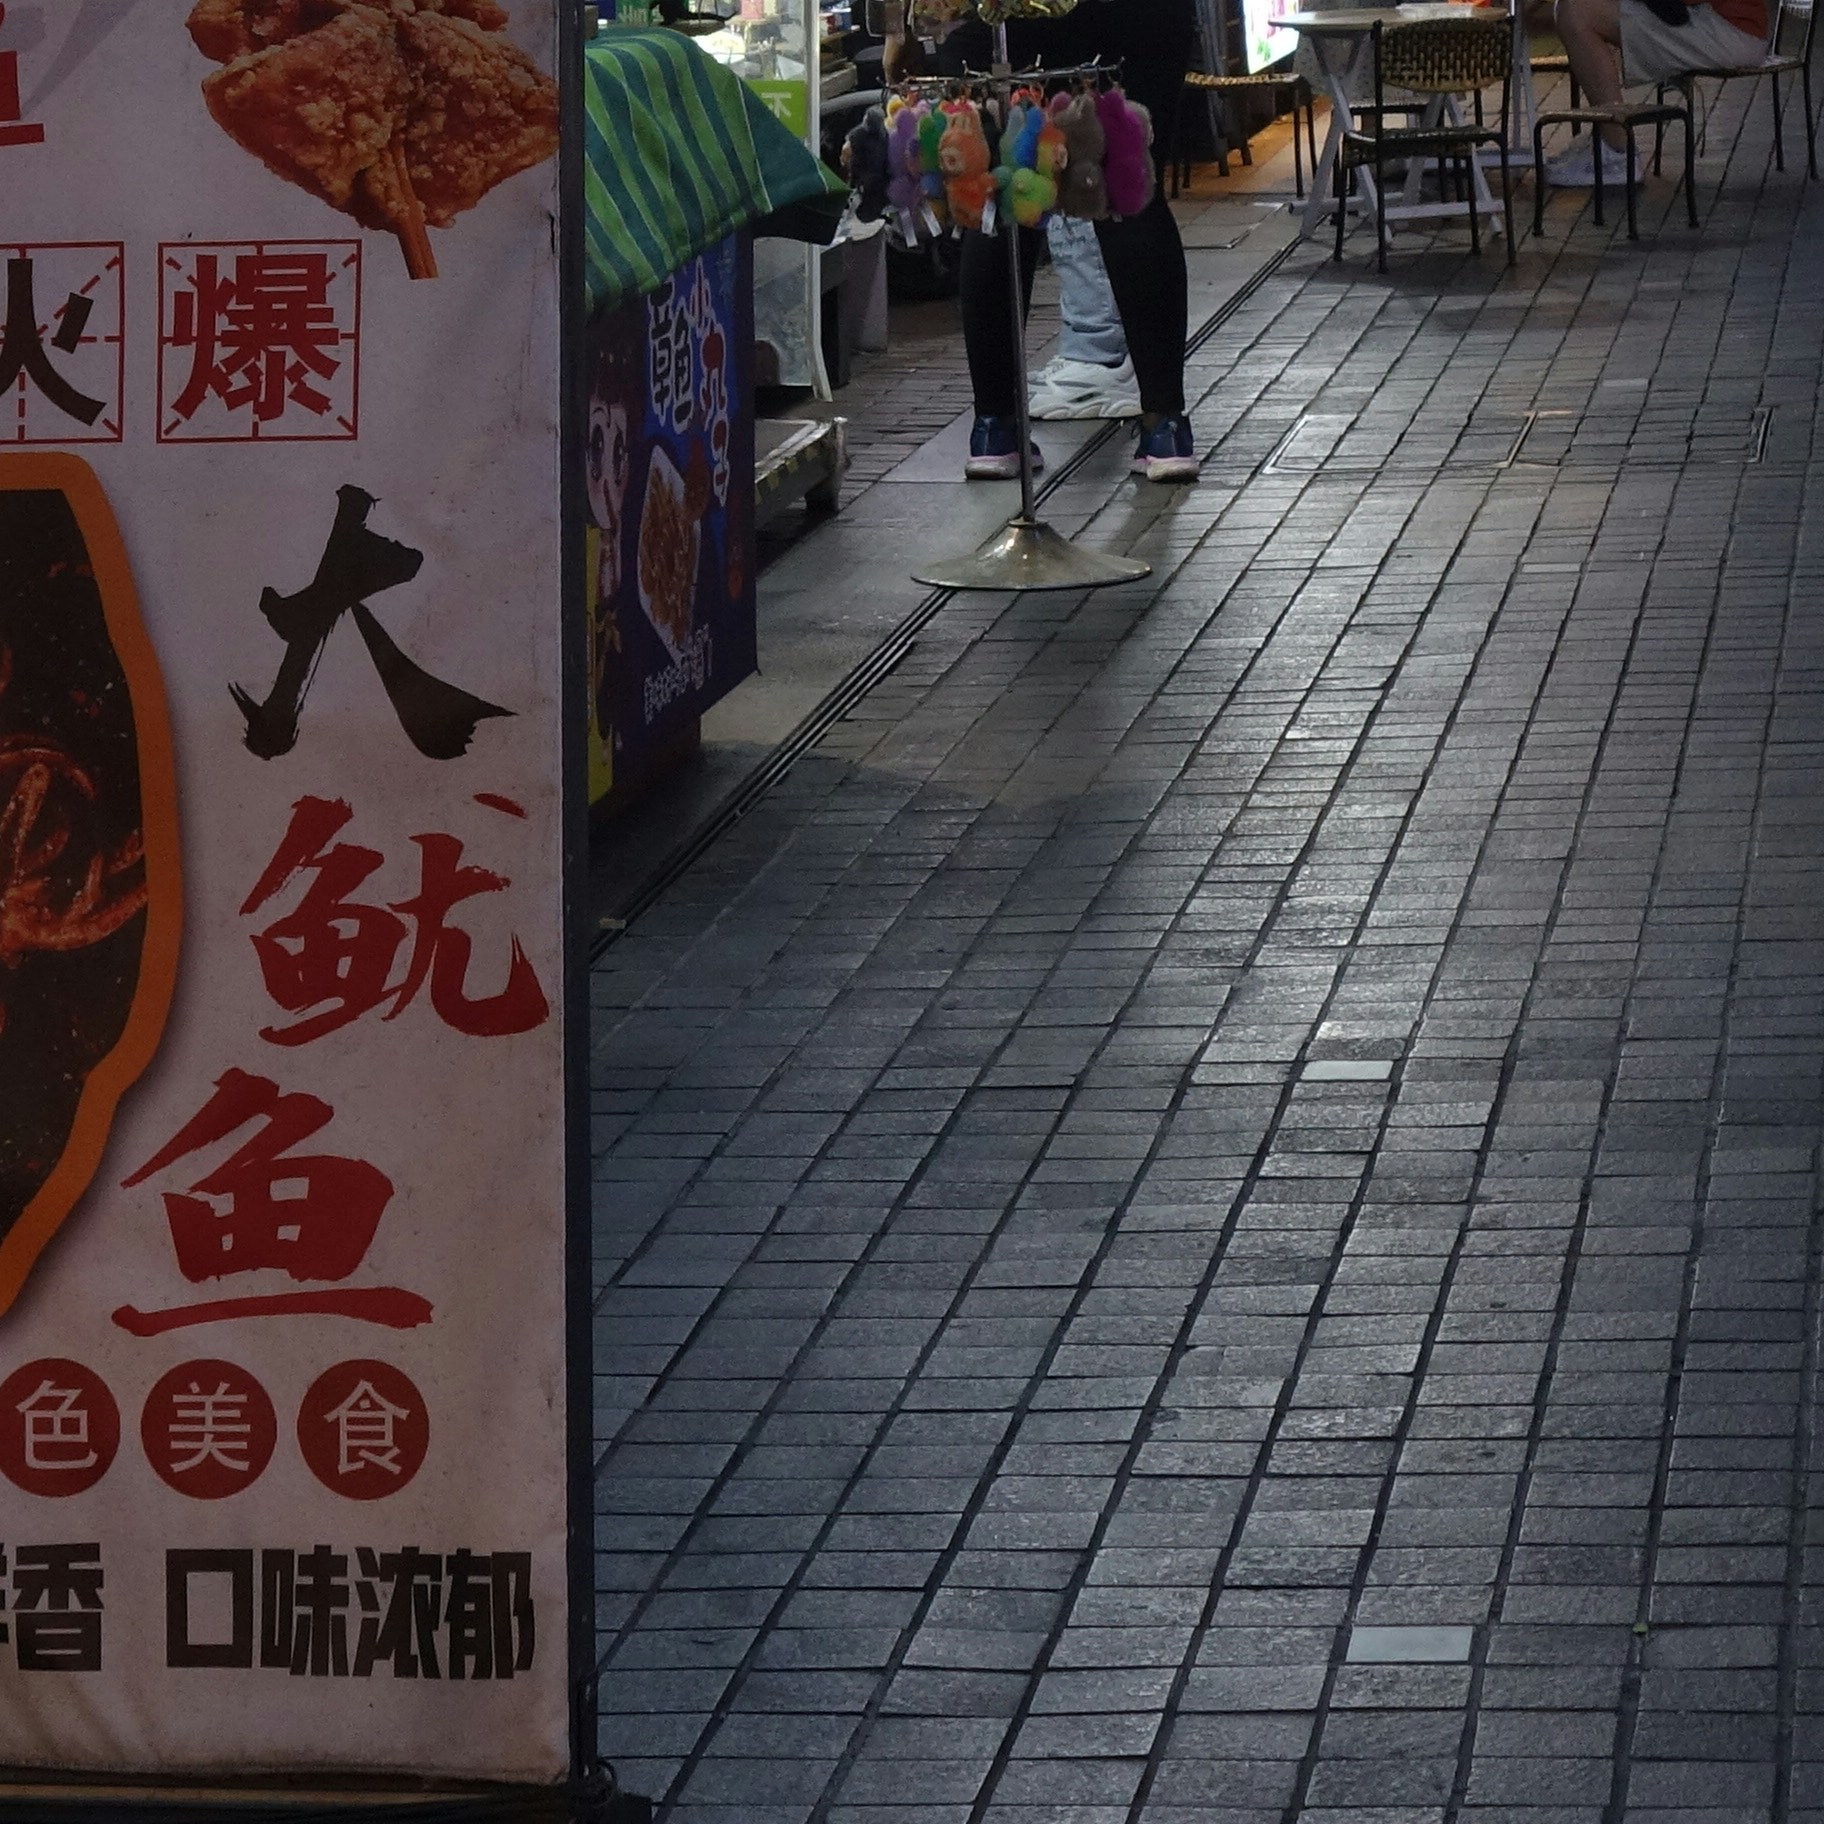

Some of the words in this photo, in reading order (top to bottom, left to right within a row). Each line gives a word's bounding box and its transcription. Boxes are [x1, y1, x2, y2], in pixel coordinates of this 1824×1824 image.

[112, 483, 552, 1336] 大鱿鱼
[165, 1544, 537, 1680] 口味浓郁
